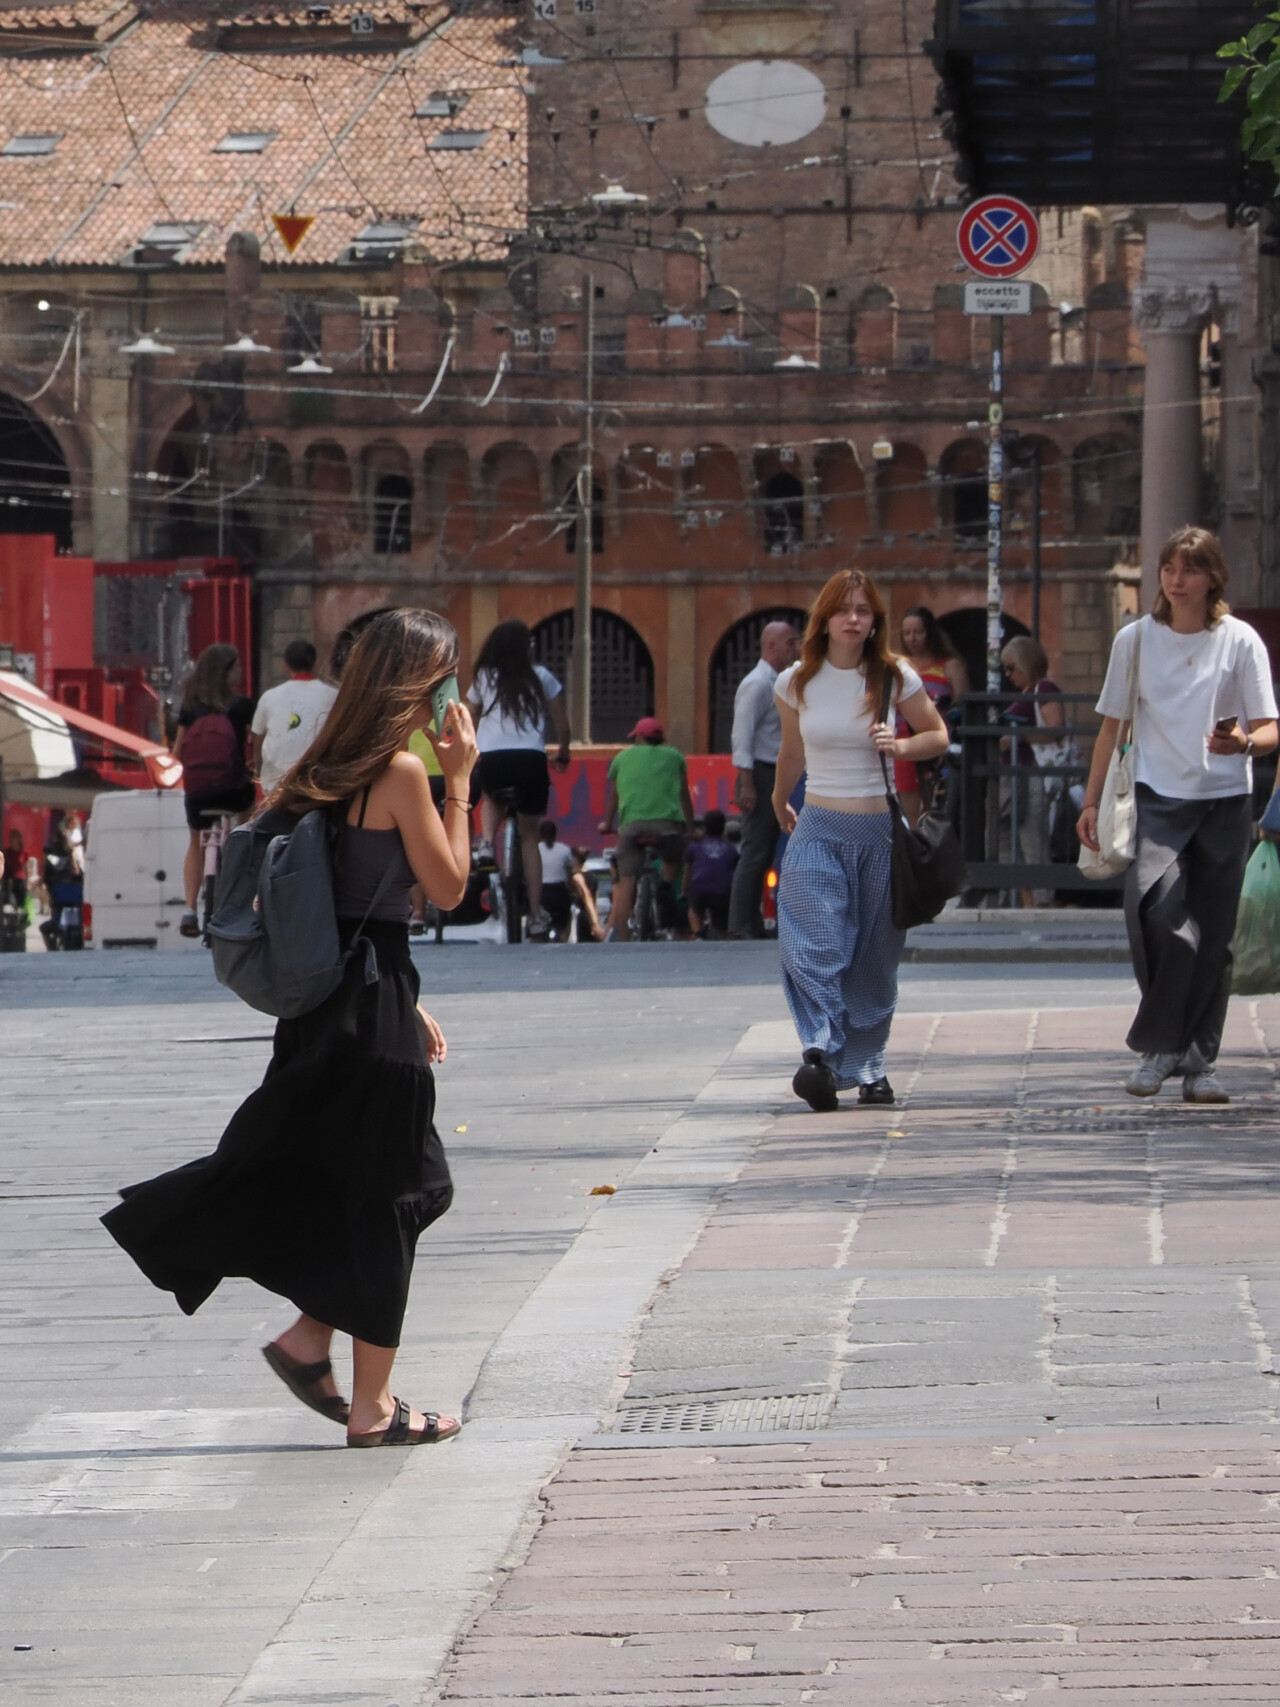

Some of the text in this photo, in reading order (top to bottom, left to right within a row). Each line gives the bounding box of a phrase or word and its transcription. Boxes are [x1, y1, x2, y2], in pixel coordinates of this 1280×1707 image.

[535, 3, 555, 16] 14
[576, 0, 594, 13] 15
[352, 17, 372, 30] 13
[974, 286, 1021, 296] eccetto
